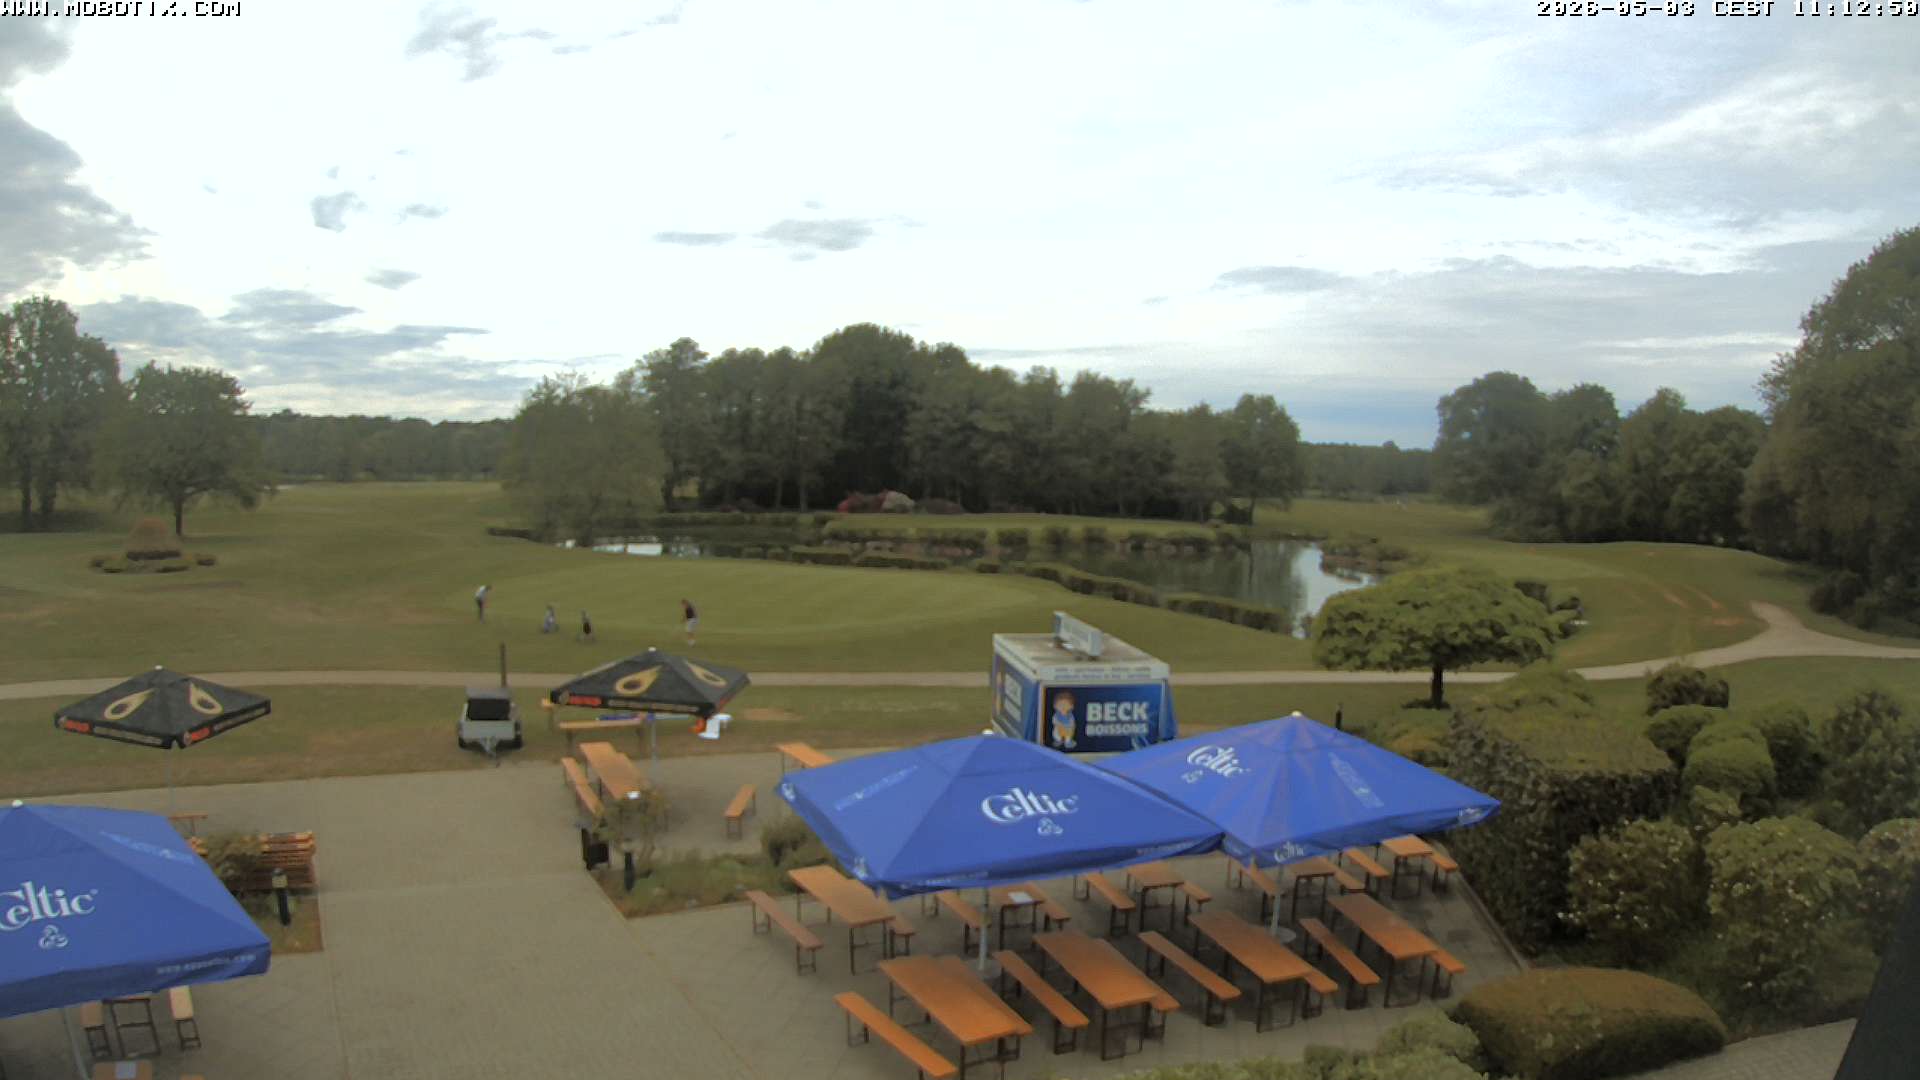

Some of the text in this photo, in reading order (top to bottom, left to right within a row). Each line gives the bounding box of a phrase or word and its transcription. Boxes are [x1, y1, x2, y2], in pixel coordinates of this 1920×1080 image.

[1086, 702, 1149, 721] BECK
[1186, 744, 1243, 777] Celtic
[982, 787, 1079, 822] Celtic
